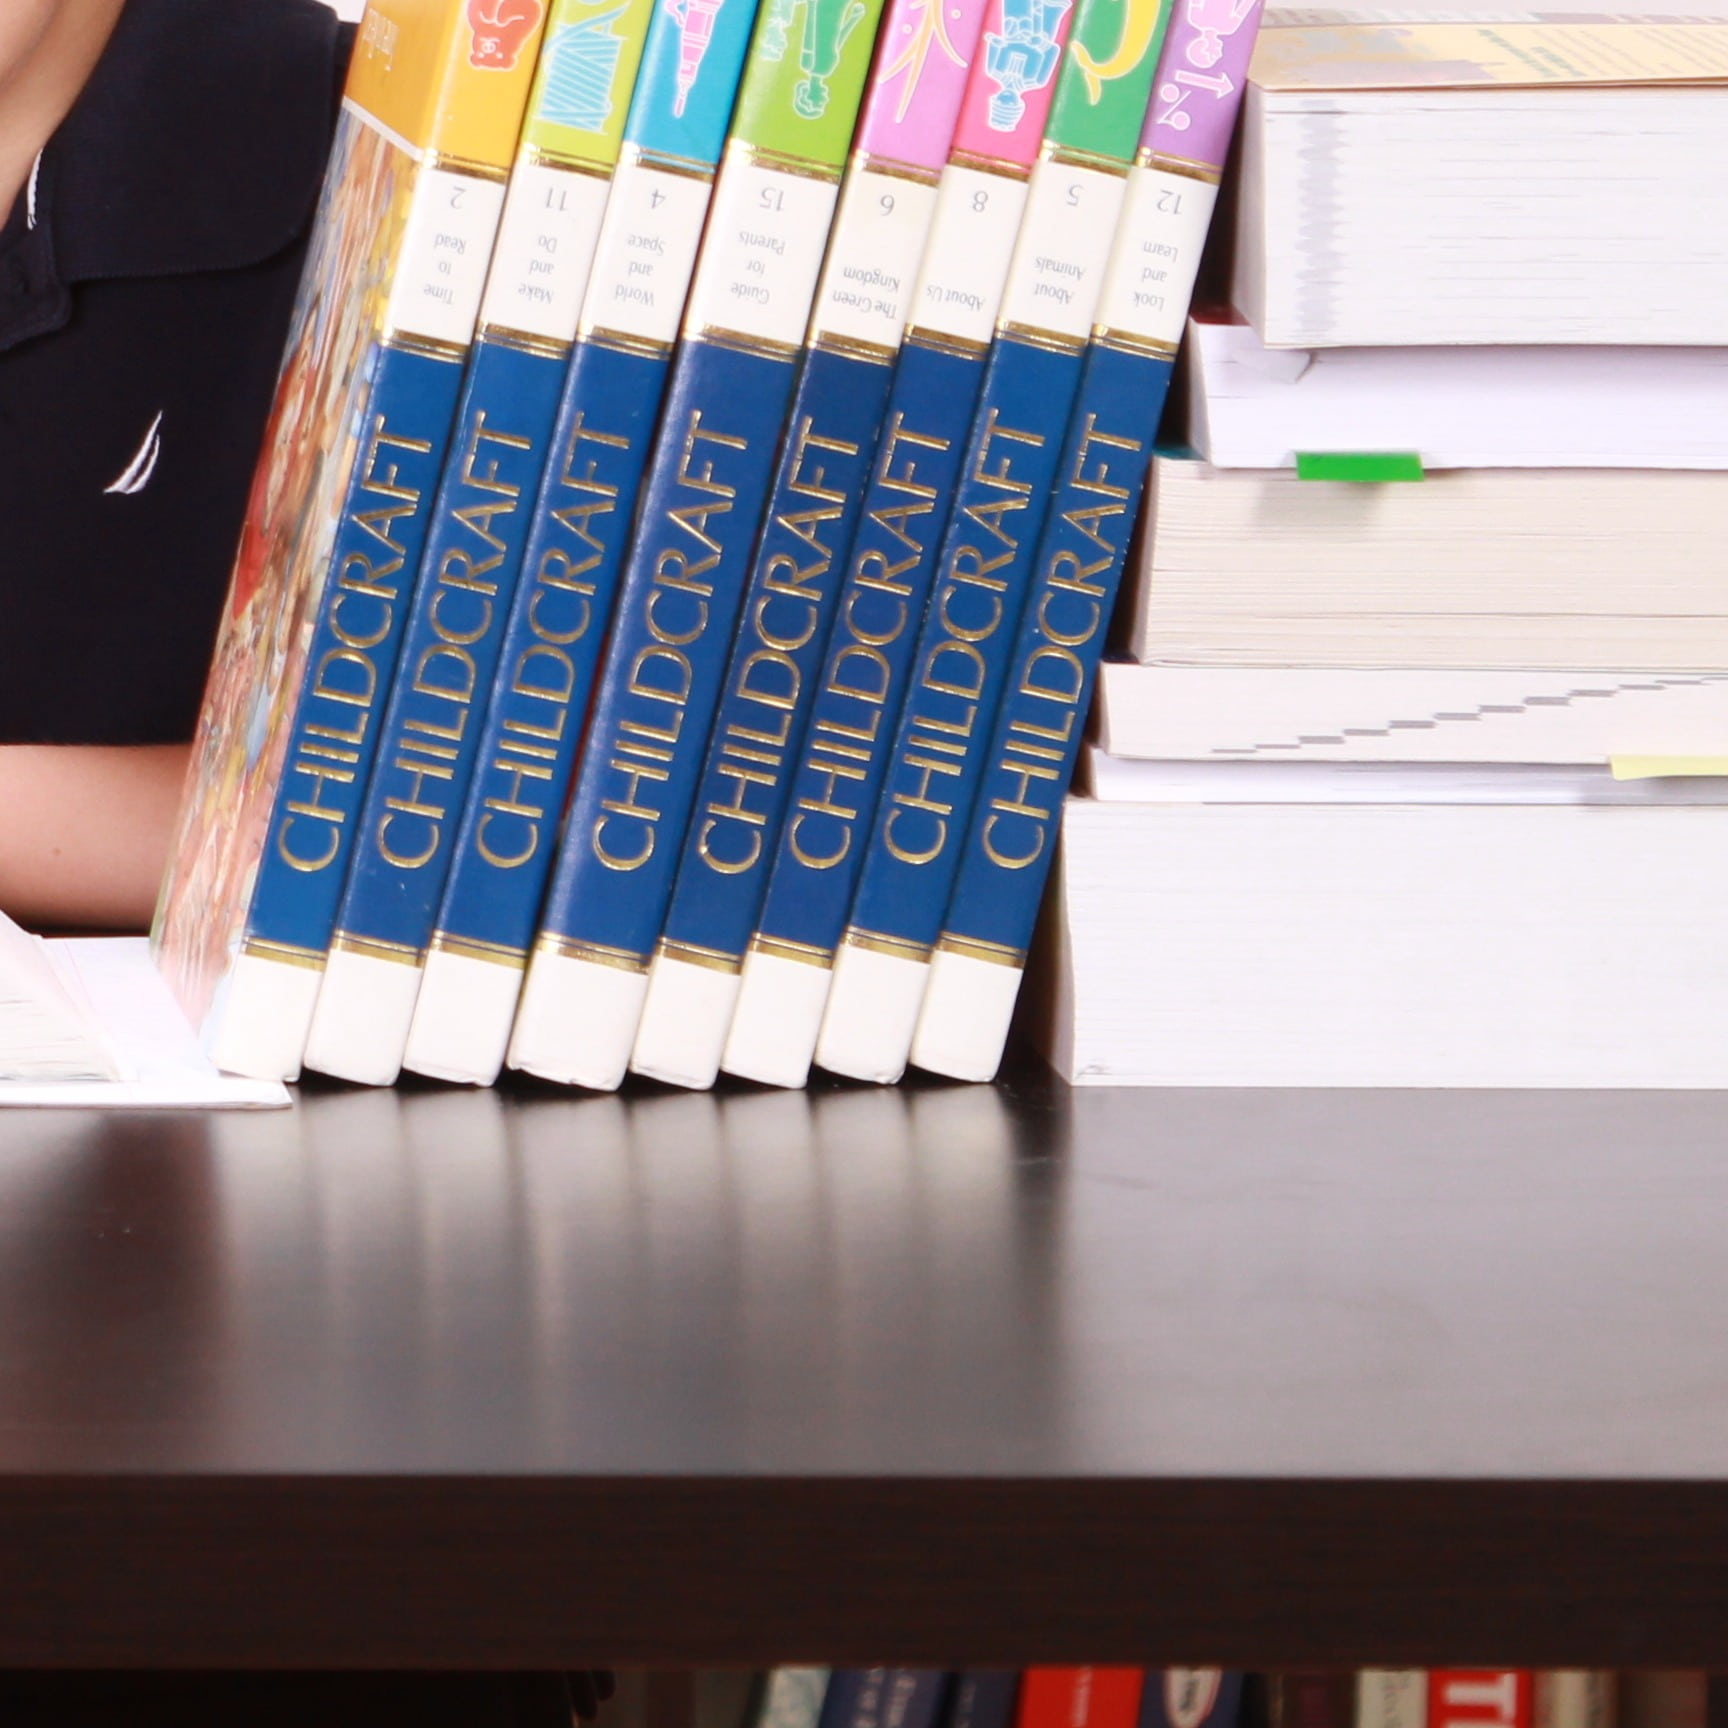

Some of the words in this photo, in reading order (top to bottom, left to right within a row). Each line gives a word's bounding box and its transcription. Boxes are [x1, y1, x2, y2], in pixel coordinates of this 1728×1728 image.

[449, 185, 467, 210] 2
[544, 186, 568, 212] 11
[650, 188, 667, 210] 4
[759, 185, 785, 212] 15
[879, 193, 896, 217] 6
[971, 189, 990, 214] 8
[1065, 182, 1086, 208] 5
[1155, 188, 1184, 216] 12
[433, 232, 467, 255] Read
[537, 234, 559, 255] Do
[626, 233, 667, 258] Space
[737, 229, 787, 257] Parents
[1142, 239, 1180, 264] Learn
[437, 260, 452, 276] to
[528, 259, 556, 275] and
[627, 260, 654, 277] and
[745, 258, 766, 276] for
[1033, 255, 1088, 282] Animals
[1141, 266, 1169, 284] and
[842, 266, 901, 294] Kingdom
[422, 283, 455, 306] Time
[517, 282, 555, 306] Make
[613, 283, 656, 308] World
[729, 281, 771, 306] Guide
[831, 288, 874, 314] Green
[925, 284, 944, 303] Us
[944, 287, 987, 313] About
[1033, 282, 1076, 306] About
[1132, 289, 1166, 313] Look
[873, 299, 898, 321] The
[277, 412, 433, 873] CHILDCRAFT
[377, 409, 533, 870] CHILDCRAFT
[476, 409, 631, 870] CHILDCRAFT
[591, 408, 747, 872] CHILDCRAFT
[697, 414, 860, 876] CHILDCRAFT
[789, 410, 951, 870] CHILDCRAFT
[885, 406, 1047, 865] CHILDCRAFT
[983, 412, 1142, 870] CHILDCRAFT
